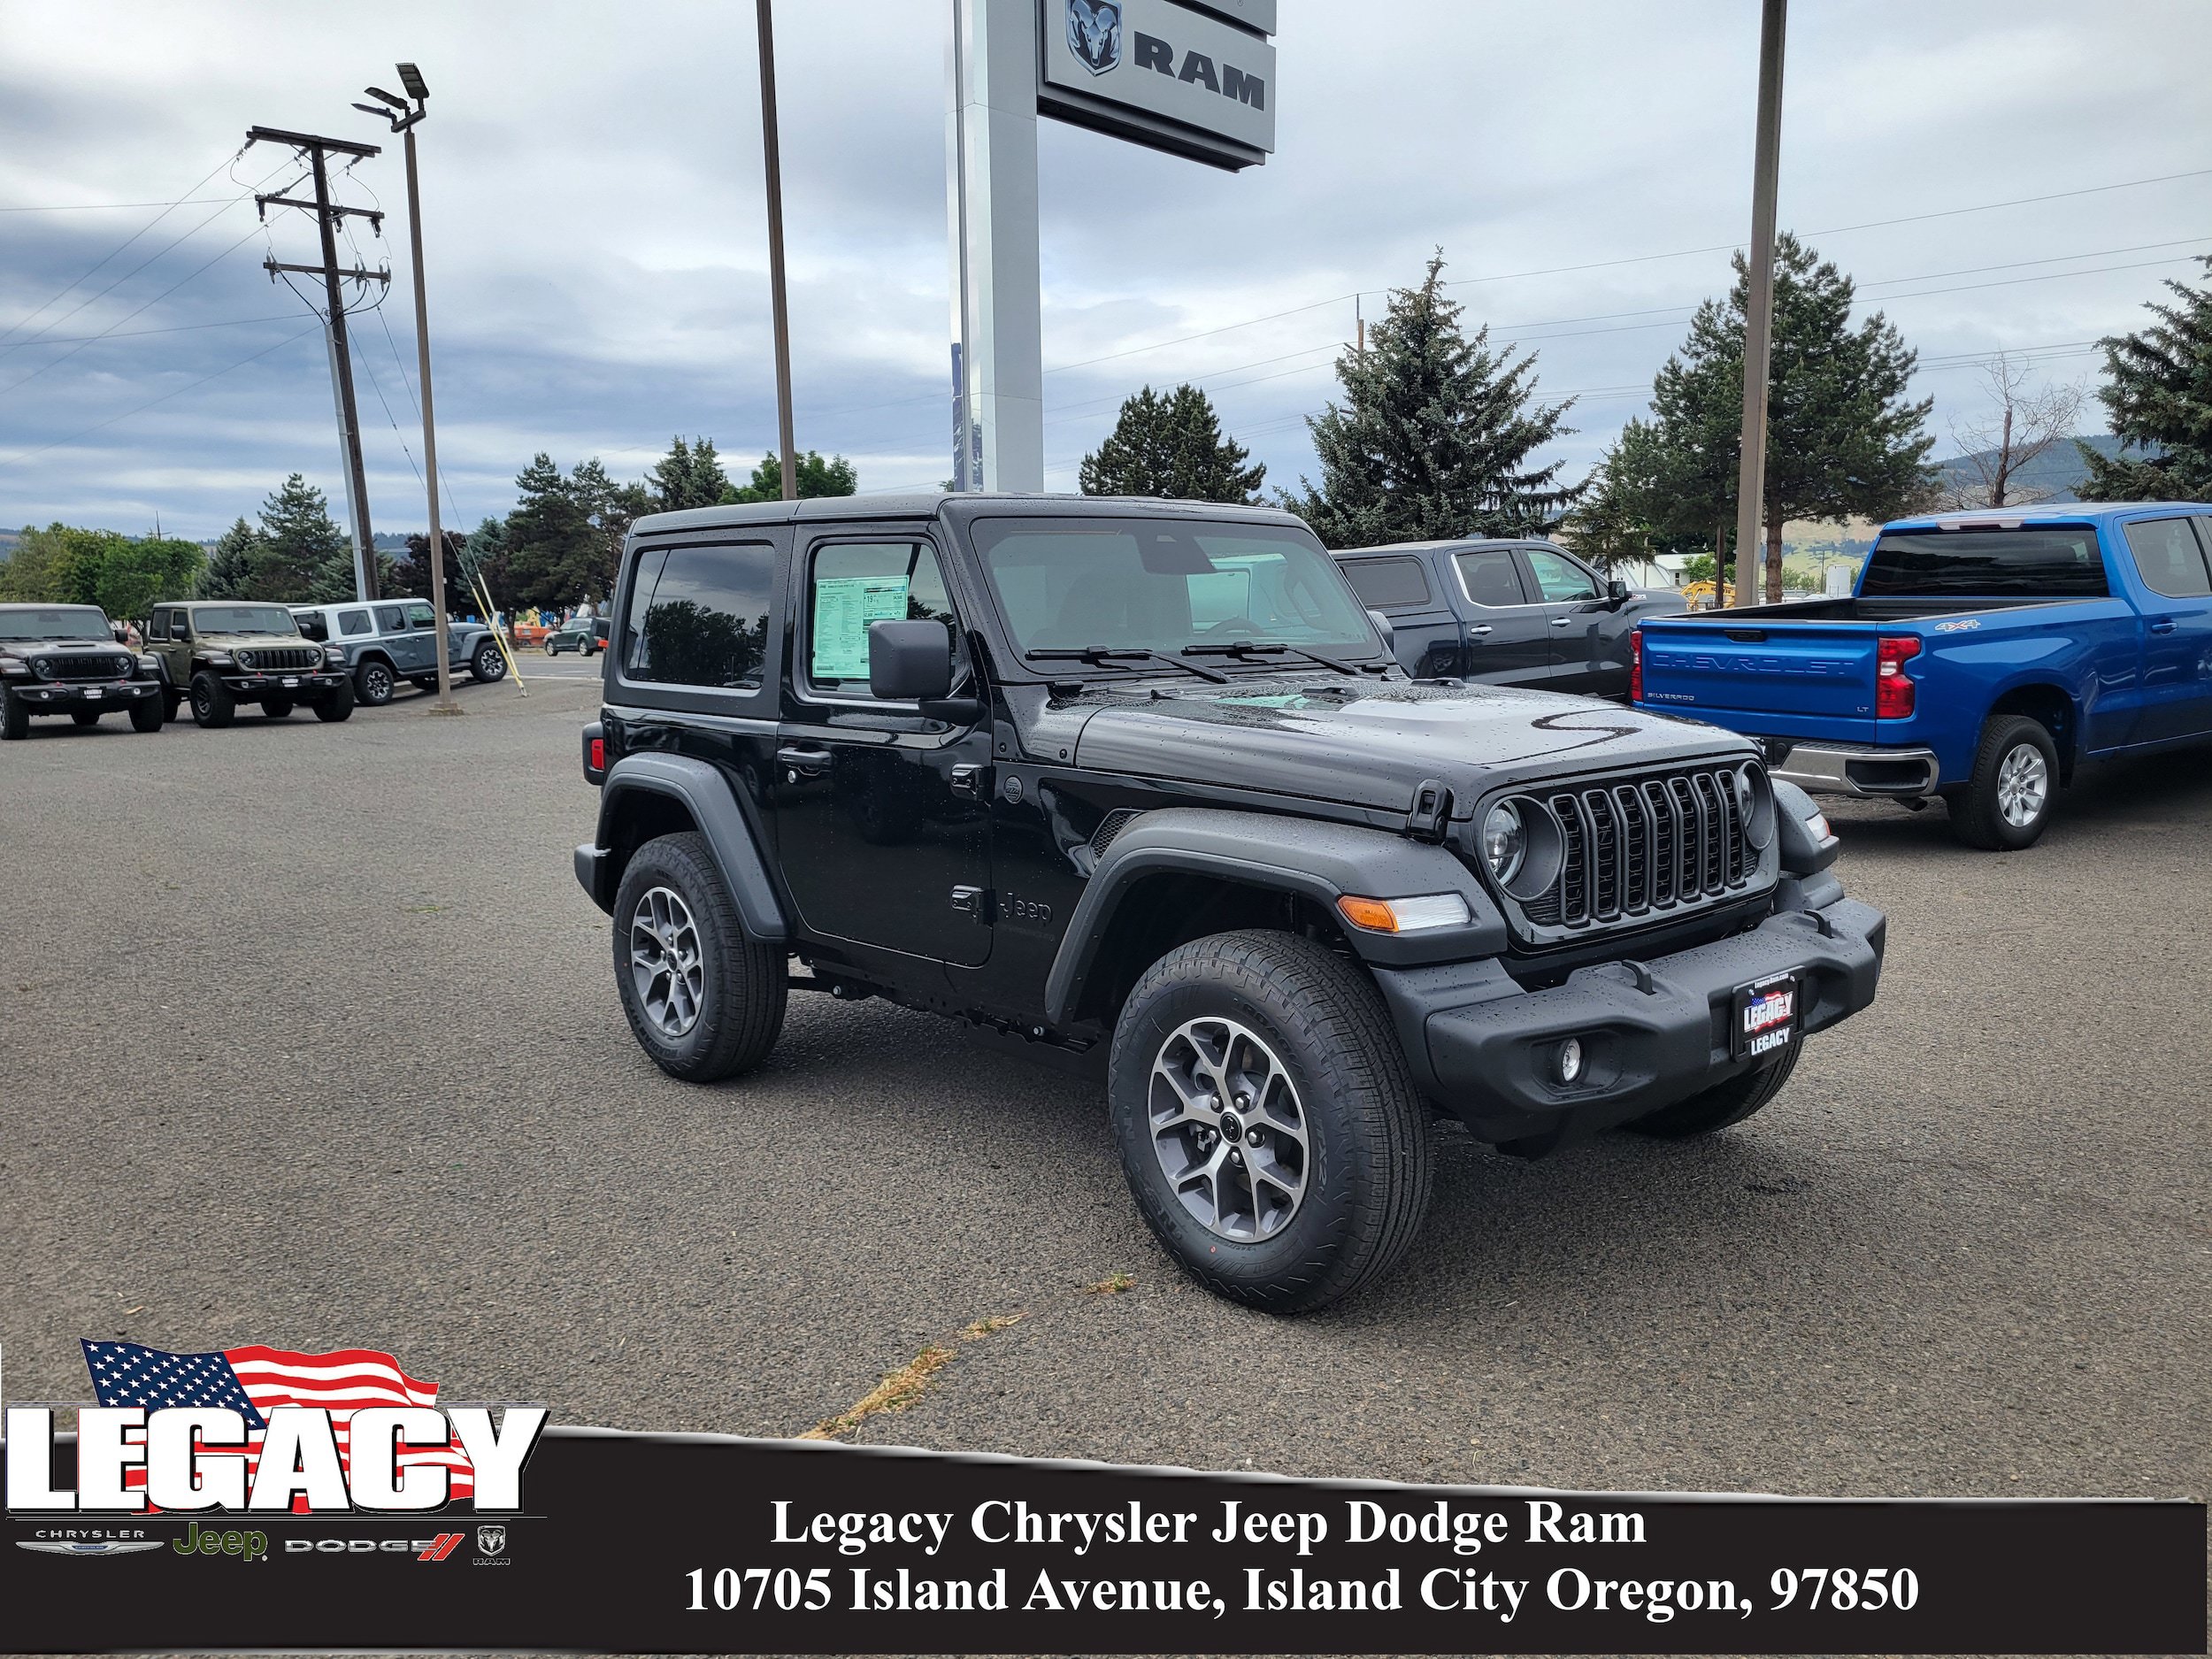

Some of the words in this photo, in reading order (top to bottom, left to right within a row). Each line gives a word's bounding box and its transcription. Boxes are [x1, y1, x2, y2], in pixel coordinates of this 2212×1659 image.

[1134, 31, 1264, 111] RAM
[1653, 655, 1855, 675] CHEVROLET
[1647, 692, 1694, 702] SILVERADO
[1000, 892, 1052, 927] Jeep
[1744, 993, 1793, 1032] LEGACY
[1751, 1028, 1790, 1056] LEGACY
